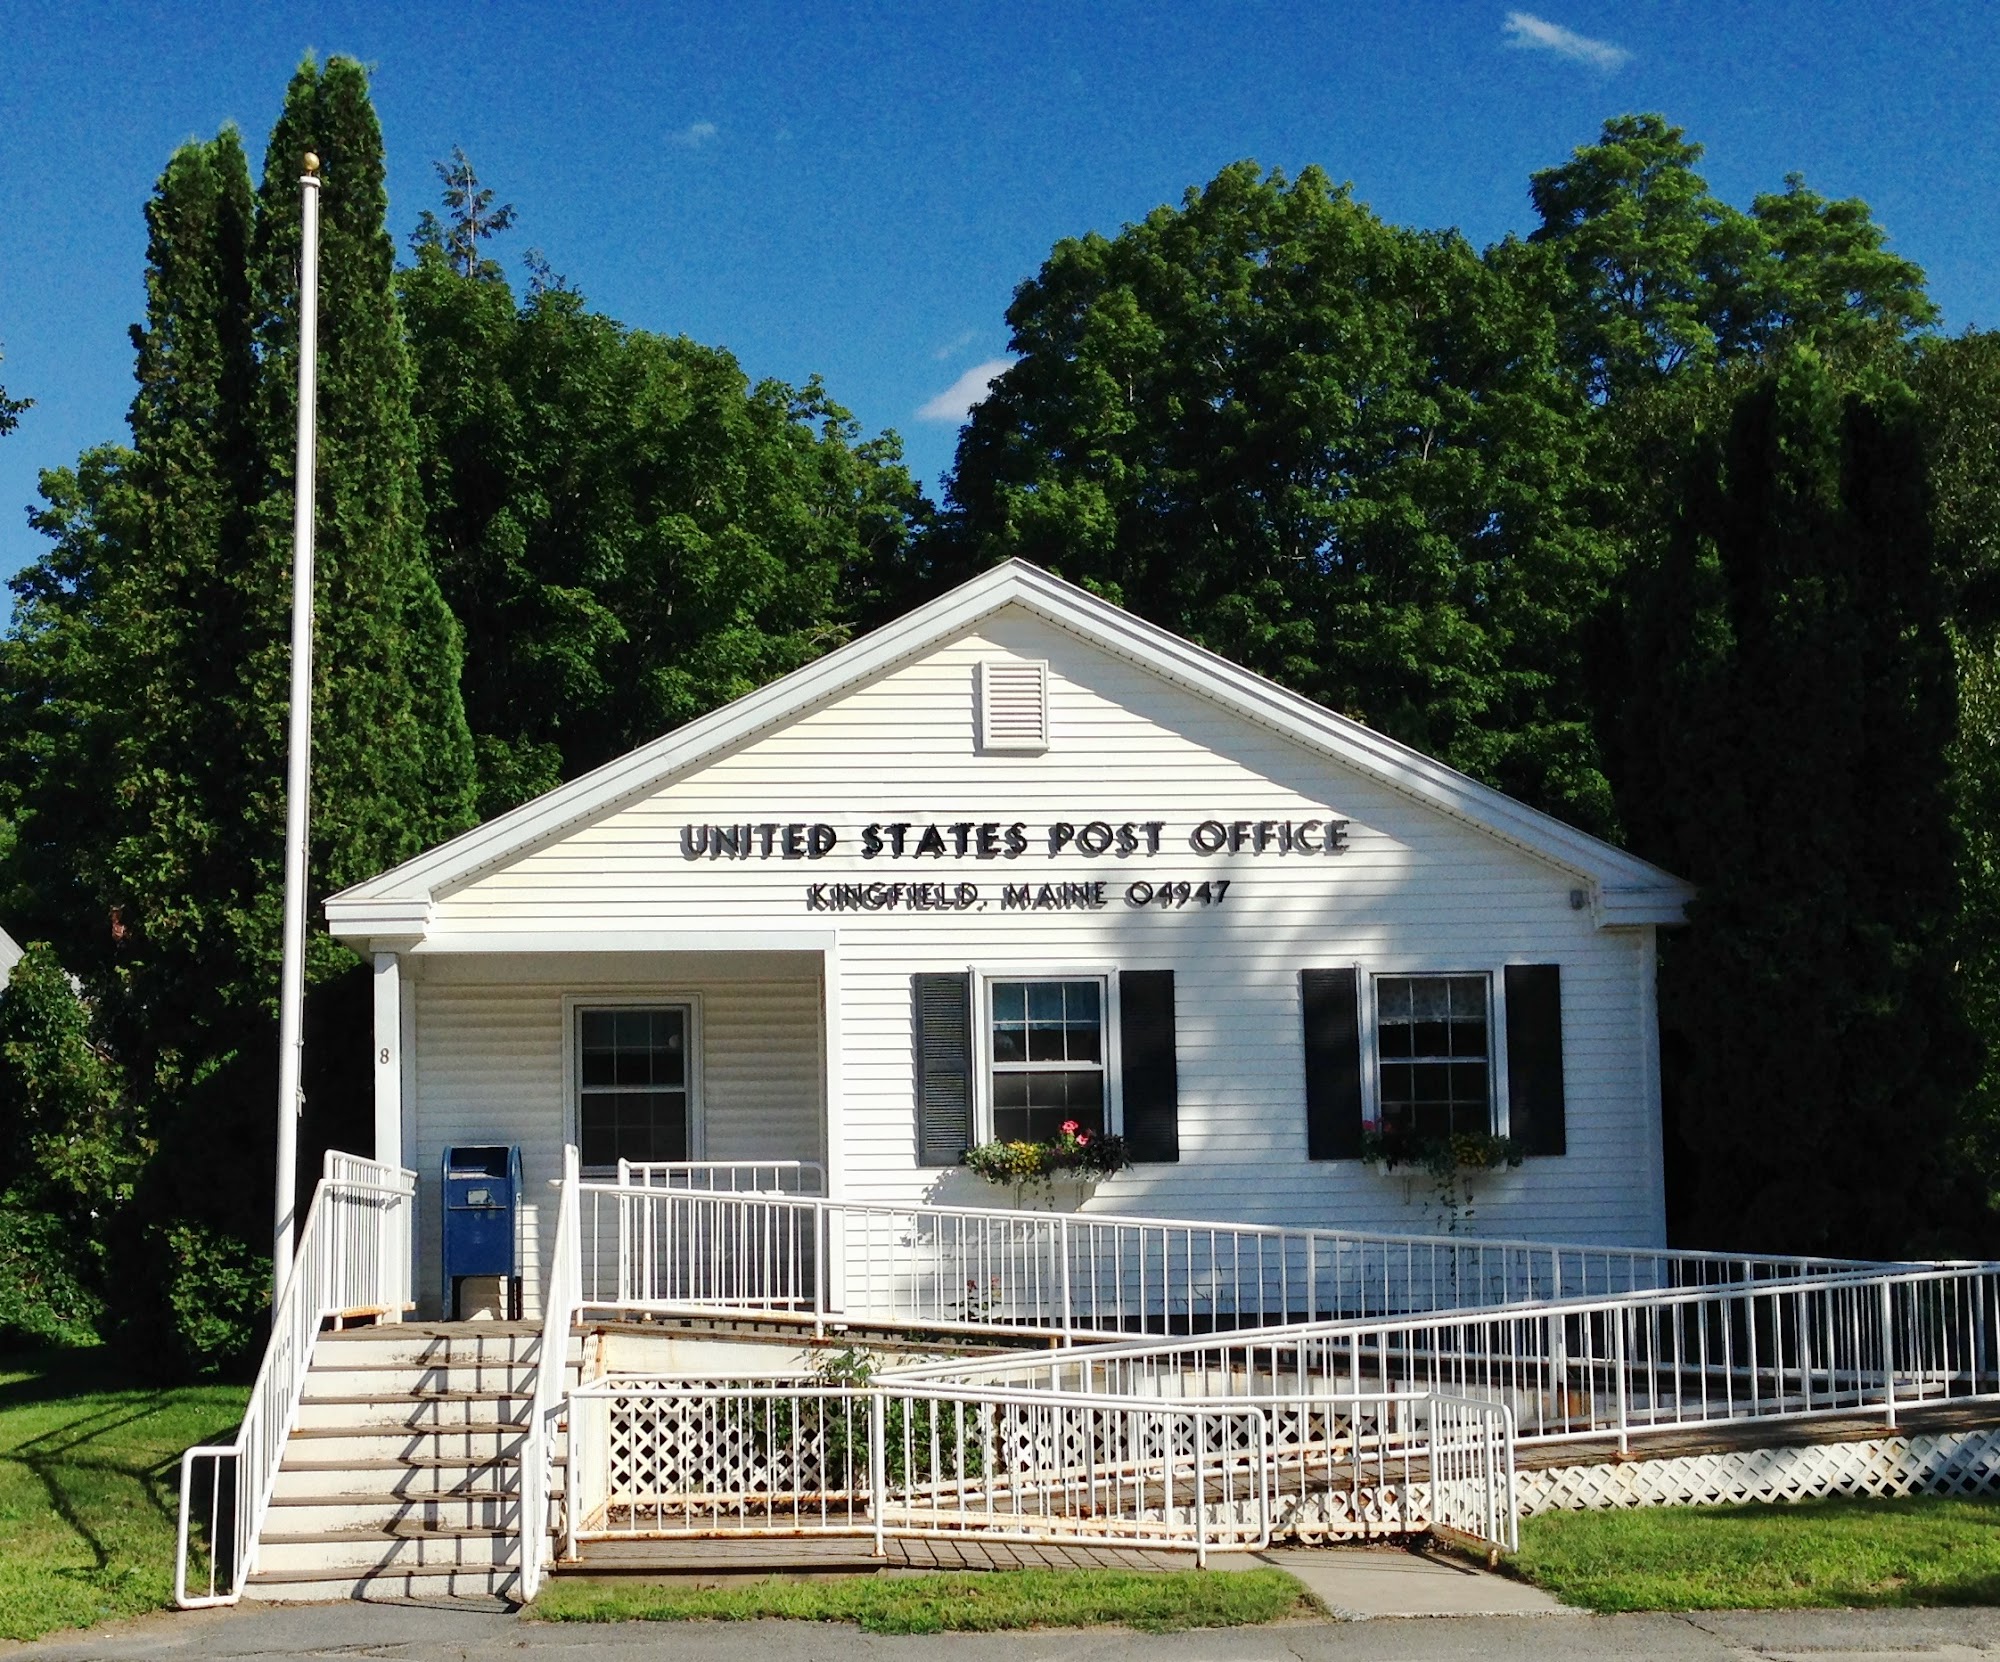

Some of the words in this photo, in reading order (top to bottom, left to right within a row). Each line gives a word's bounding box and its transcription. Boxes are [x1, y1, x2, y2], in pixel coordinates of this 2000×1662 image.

[684, 823, 837, 857] UNITED
[861, 822, 1028, 856] STATES
[1052, 820, 1166, 855] POST
[1193, 819, 1350, 854] OFFICE
[1004, 881, 1108, 908] MAINE
[1127, 880, 1231, 907] 04947
[380, 1047, 389, 1065] 8
